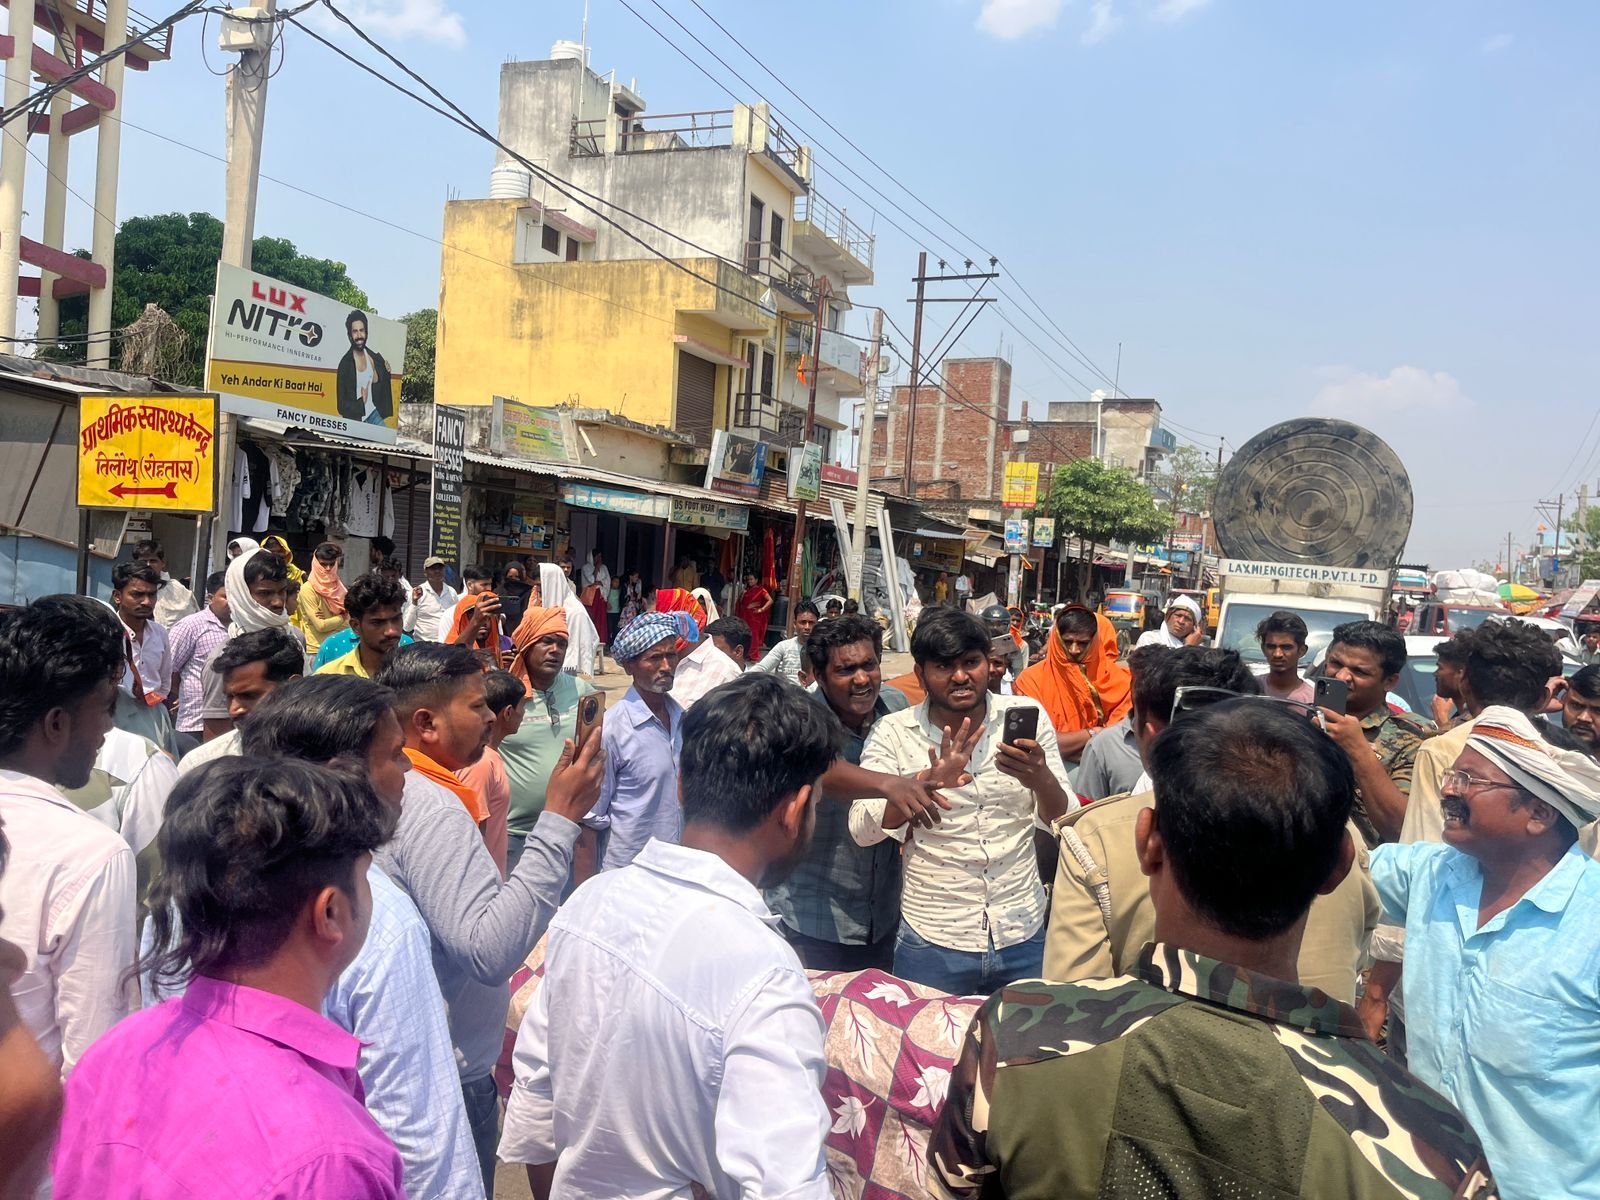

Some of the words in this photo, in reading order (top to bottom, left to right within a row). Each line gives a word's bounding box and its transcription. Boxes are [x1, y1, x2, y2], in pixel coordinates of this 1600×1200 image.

[251, 281, 307, 314] LUX
[225, 331, 285, 352] HI-PERFORMANCE
[286, 348, 322, 361] INNERWEAR
[220, 374, 240, 385] Yeh
[241, 376, 272, 388] Andar
[273, 378, 283, 389] Ki
[284, 379, 307, 390] Baat
[307, 381, 323, 392] Hai
[81, 403, 138, 456] प्राथमिक
[276, 408, 307, 423] FANCY
[309, 415, 348, 431] DRESSES
[436, 415, 464, 447] FANCY
[140, 453, 200, 485] (रोहतास)
[435, 445, 464, 473] DRESSES
[435, 492, 462, 503] COLLECTION
[441, 483, 454, 492] WEAR
[684, 500, 700, 511] FOOT
[700, 502, 715, 513] WEAR
